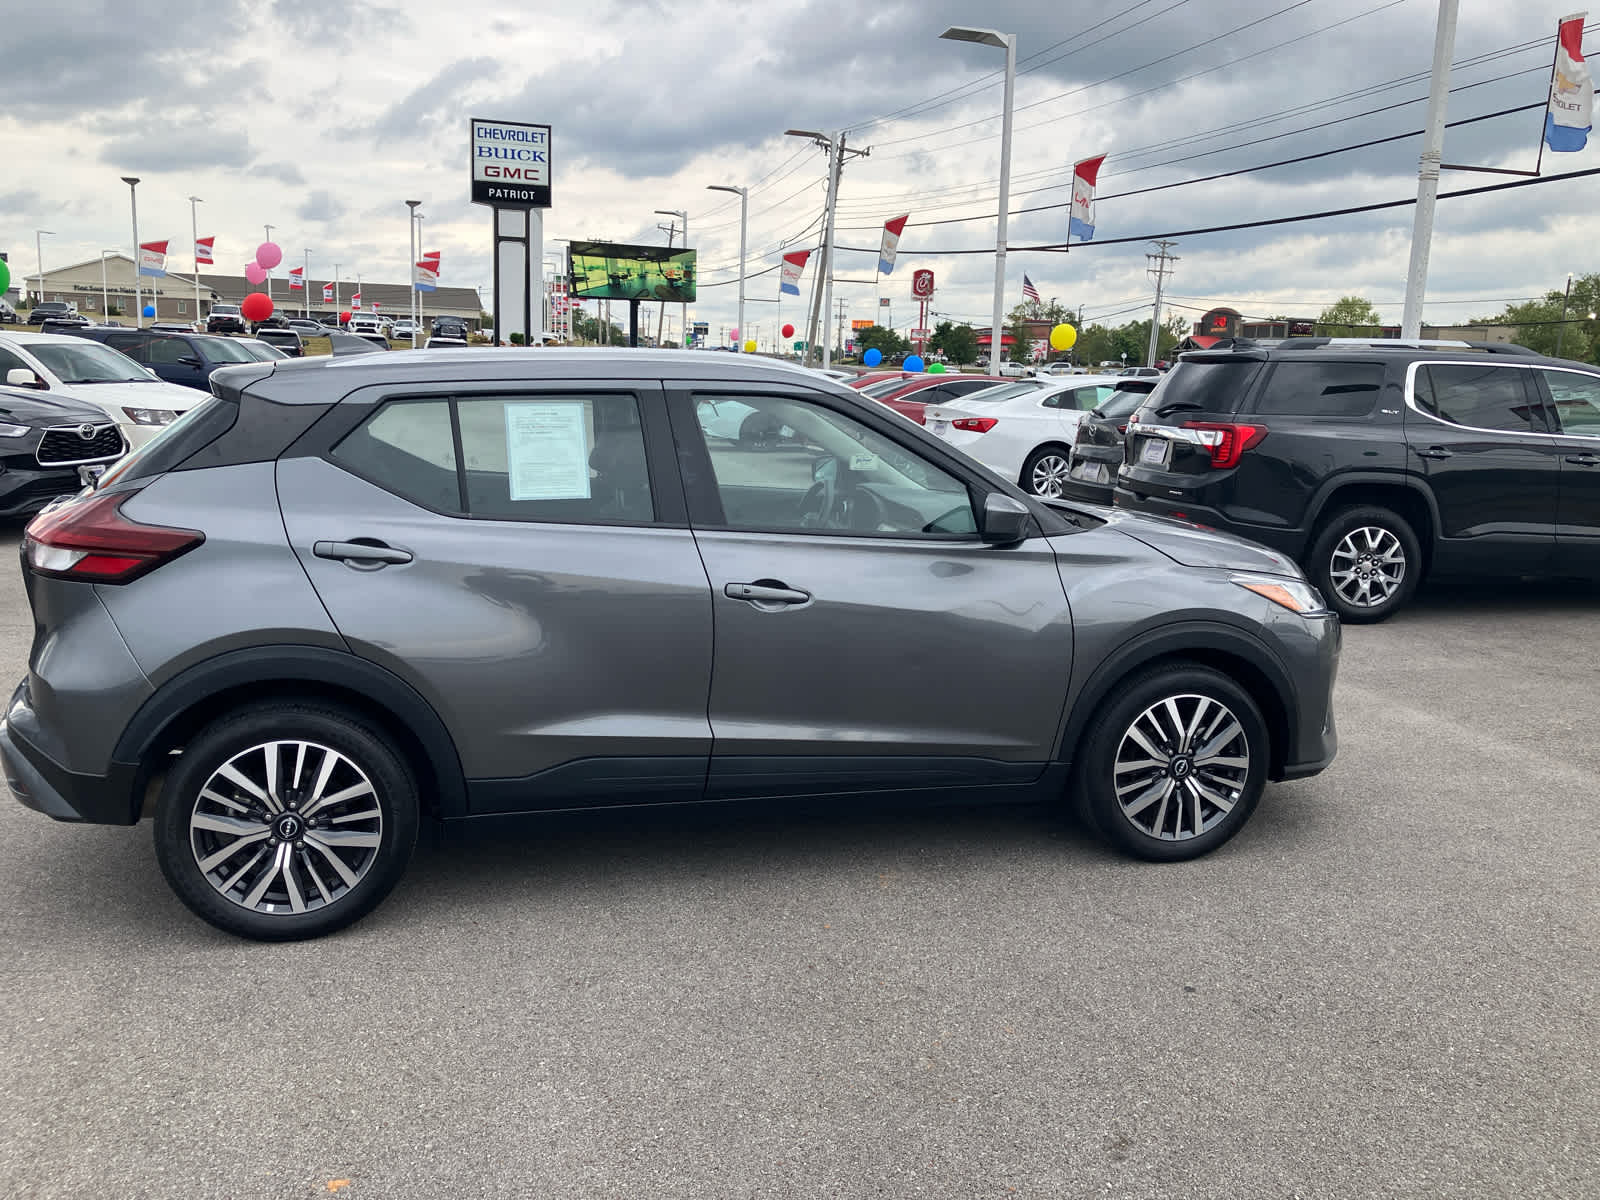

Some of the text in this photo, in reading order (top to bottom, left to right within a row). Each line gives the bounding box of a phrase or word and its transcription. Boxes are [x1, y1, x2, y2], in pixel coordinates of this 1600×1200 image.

[477, 127, 546, 143] CHEVROLET
[478, 146, 546, 163] BUICK
[484, 166, 539, 181] GMC
[488, 188, 535, 200] PATRIOT
